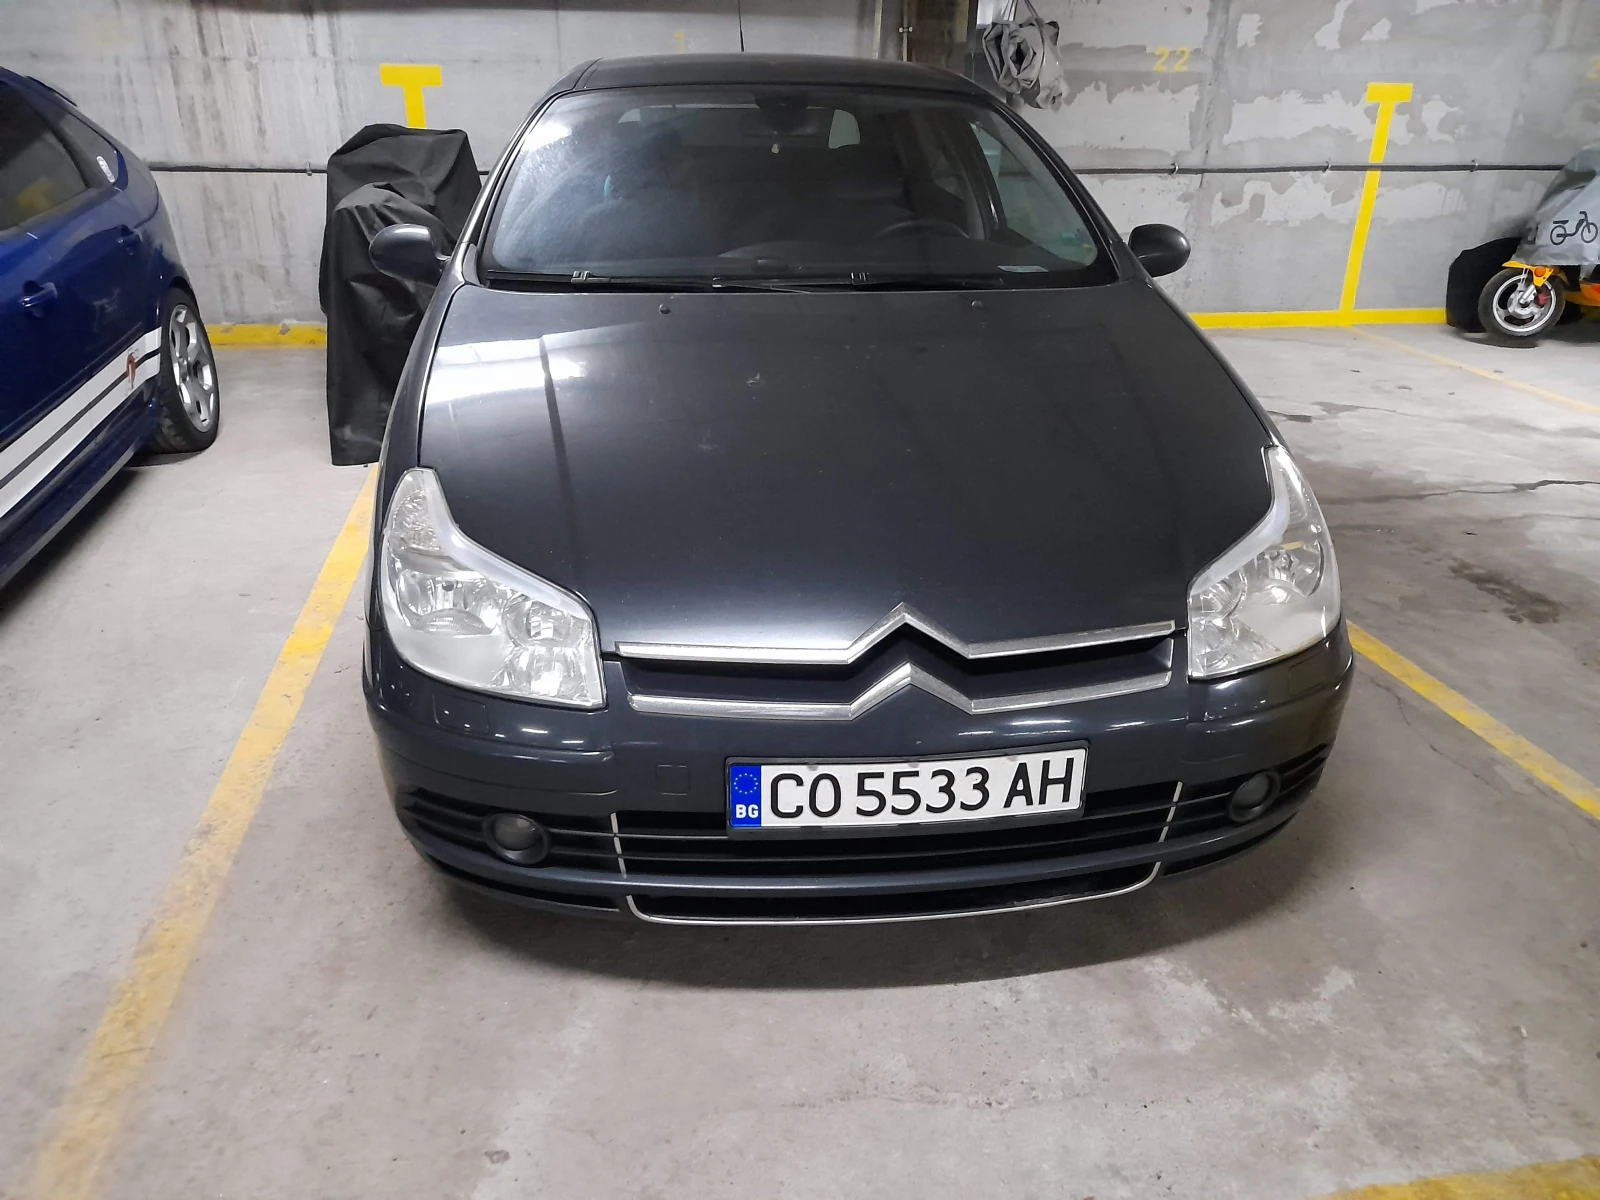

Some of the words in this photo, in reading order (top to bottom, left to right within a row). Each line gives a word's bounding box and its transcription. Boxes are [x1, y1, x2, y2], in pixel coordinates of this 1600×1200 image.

[1153, 47, 1190, 71] 22
[855, 766, 990, 817] 5533
[1003, 757, 1075, 809] AH
[735, 804, 759, 819] BG
